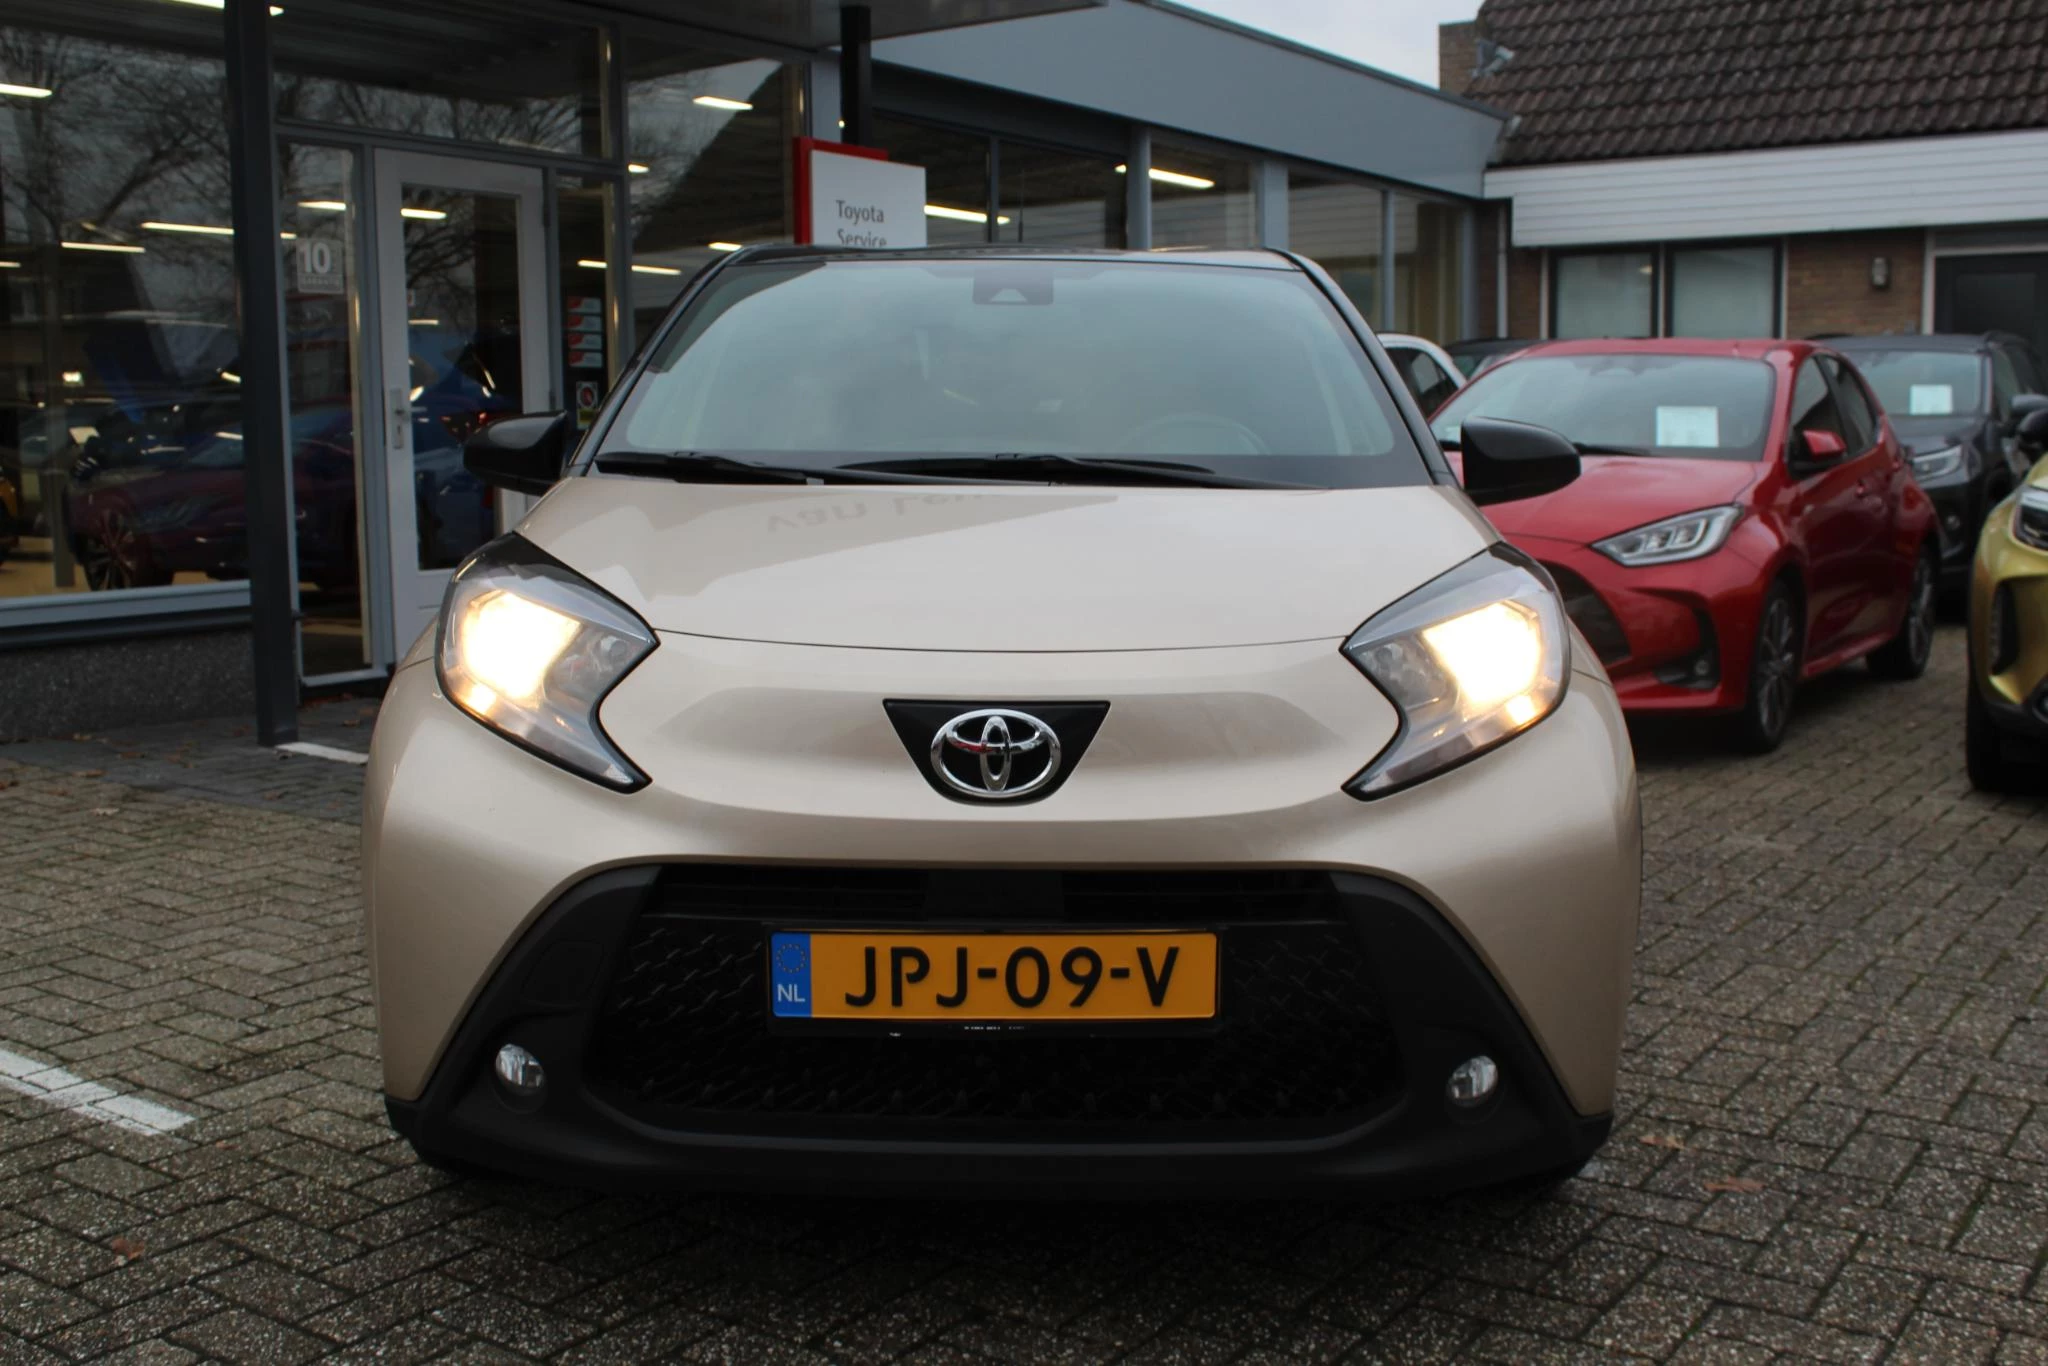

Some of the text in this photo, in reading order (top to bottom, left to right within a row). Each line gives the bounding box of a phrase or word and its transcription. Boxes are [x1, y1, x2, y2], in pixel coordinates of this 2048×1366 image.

[836, 200, 884, 225] Toyota
[837, 228, 887, 248] Service
[299, 242, 331, 273] 10
[845, 946, 1179, 1008] JPJ-09-V
[776, 984, 805, 1003] NL
